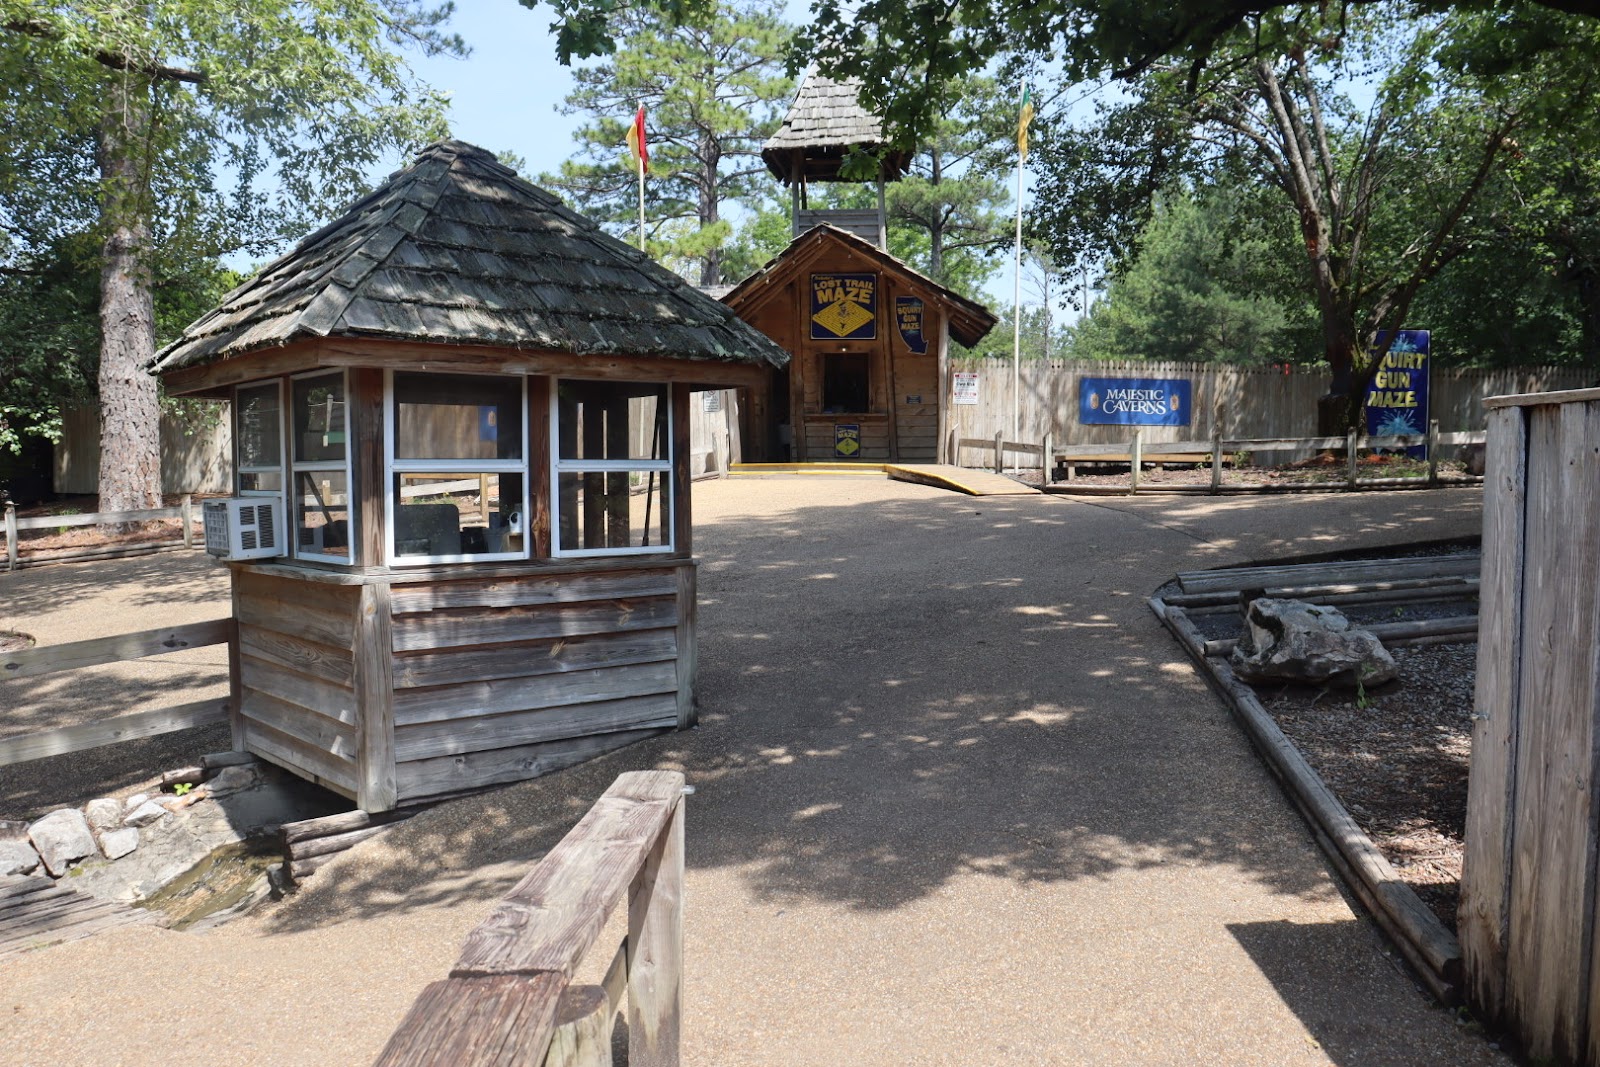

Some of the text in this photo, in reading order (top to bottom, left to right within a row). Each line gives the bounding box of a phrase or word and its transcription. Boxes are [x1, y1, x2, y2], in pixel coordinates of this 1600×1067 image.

[814, 279, 874, 290] LOST TRAIL
[816, 287, 873, 304] MAZE
[897, 306, 922, 315] SQUIRT
[903, 314, 917, 322] GUN
[901, 322, 920, 330] MAZE
[1375, 371, 1411, 389] GUN
[1106, 388, 1164, 401] MAJESTIC
[1367, 390, 1418, 408] MAZE
[1102, 399, 1167, 415] CAVERNS
